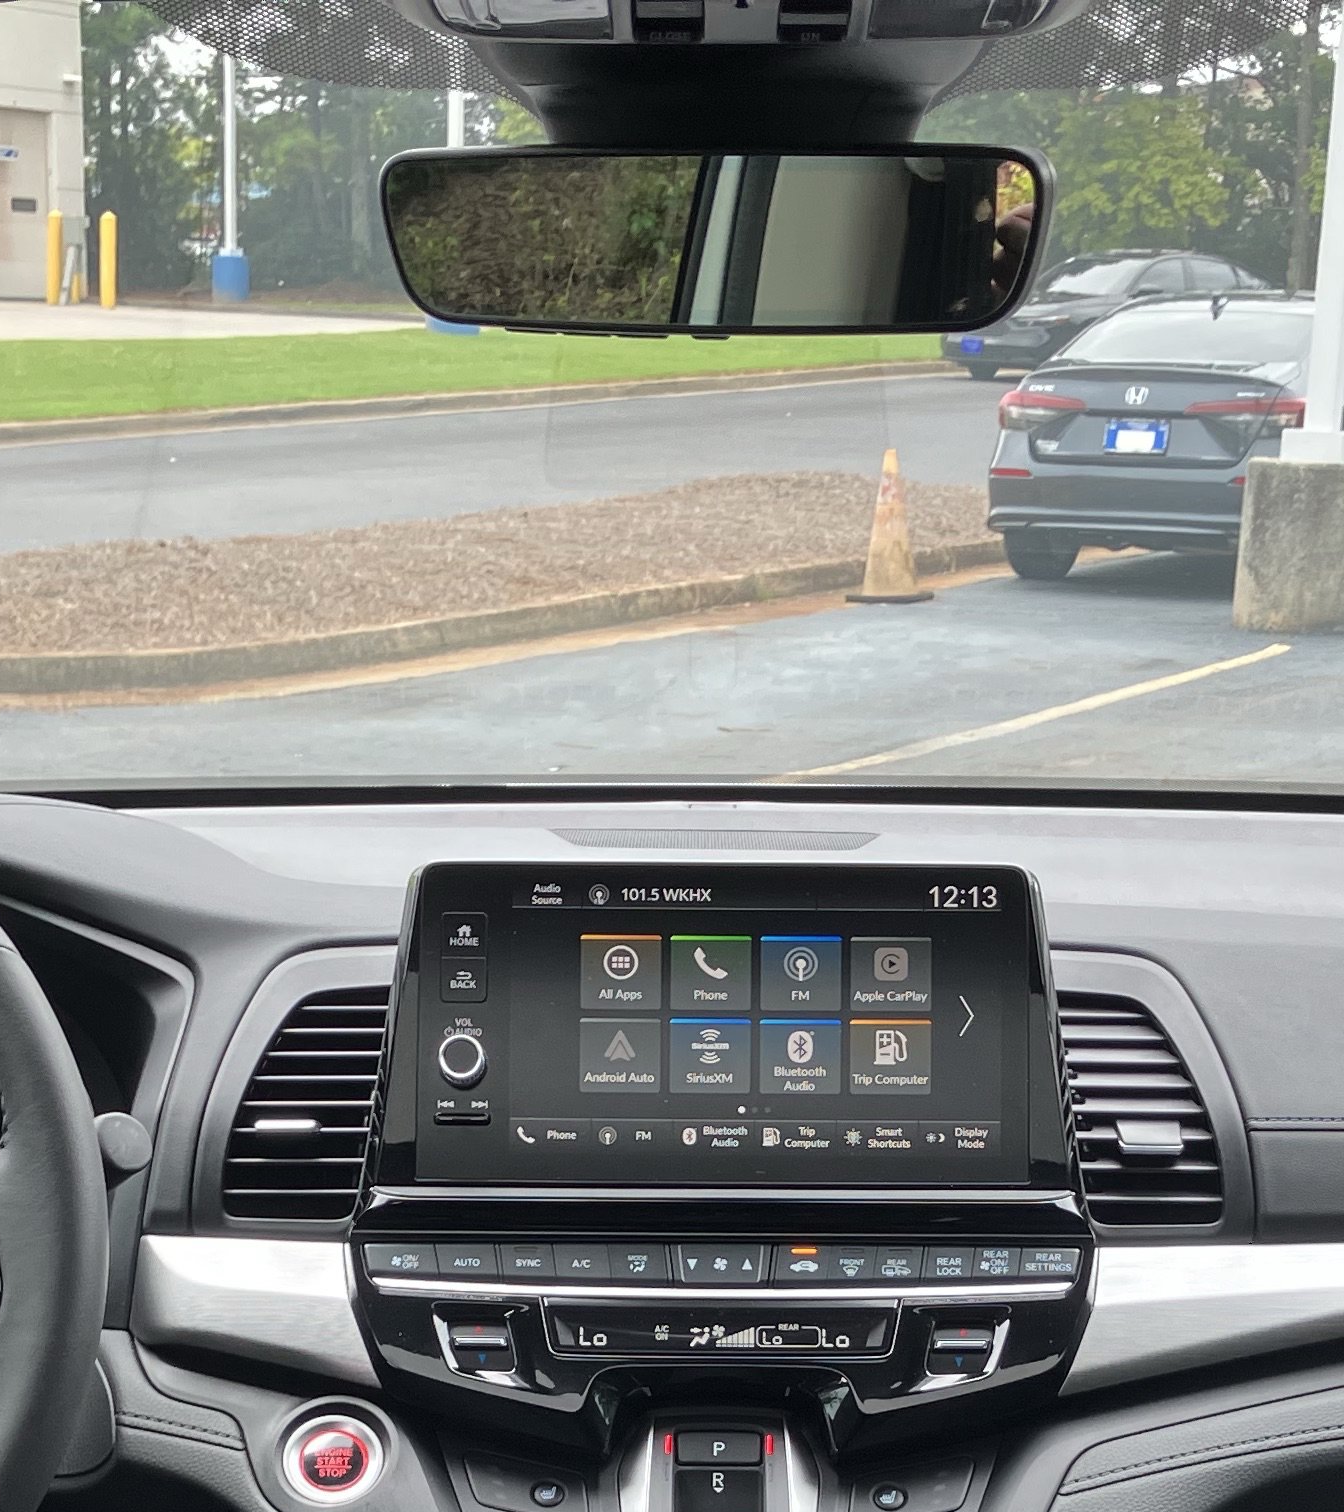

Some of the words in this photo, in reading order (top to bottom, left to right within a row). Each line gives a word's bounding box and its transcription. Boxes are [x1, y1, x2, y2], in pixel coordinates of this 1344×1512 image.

[533, 883, 562, 893] Audio
[531, 895, 563, 905] Source
[621, 888, 660, 902] 101.5
[662, 888, 712, 902] WKHX
[928, 886, 998, 908] 12:13
[449, 937, 479, 946] HOME
[450, 980, 476, 989] BACK
[598, 988, 613, 1000] All
[615, 989, 643, 1001] Apps
[693, 989, 728, 1000] Phone
[791, 990, 810, 1001] FM
[853, 991, 884, 1003] Apple
[886, 991, 928, 1003] CarPlay
[455, 1017, 473, 1026] VOL
[454, 1027, 482, 1036] AUDIO
[773, 1066, 826, 1077] Bluetooth
[583, 1072, 626, 1083] Android
[628, 1072, 655, 1083] Auto
[686, 1073, 733, 1084] SiriusXM
[852, 1074, 873, 1086] Trip
[874, 1074, 929, 1086] Computer
[783, 1081, 815, 1092] Audio
[546, 1130, 577, 1140] Phone
[635, 1130, 652, 1140] FM
[703, 1126, 748, 1136] Bluetooth
[798, 1126, 816, 1138] Trip
[875, 1127, 903, 1137] Smart
[954, 1127, 989, 1139] Display
[711, 1137, 739, 1147] Audio
[784, 1138, 830, 1149] Computer
[867, 1138, 911, 1149] Shortcuts
[957, 1139, 985, 1149] Mode
[983, 1250, 1009, 1259] REAR
[1035, 1253, 1061, 1262] REAR
[402, 1262, 419, 1270] OFF
[453, 1258, 481, 1267] AUTO
[515, 1258, 541, 1268] SYNC
[572, 1259, 591, 1268] A/C
[839, 1258, 864, 1266] FRONT
[936, 1257, 962, 1266] REAR
[936, 1267, 962, 1276] LOCK
[989, 1266, 1009, 1275] OFF
[1024, 1263, 1072, 1272] SETTINGS
[654, 1325, 670, 1333] A/C
[778, 1323, 799, 1331] REAR
[655, 1333, 669, 1341] ON
[712, 1441, 726, 1457] P
[316, 1457, 351, 1466] START
[318, 1468, 347, 1478] STOP
[712, 1472, 725, 1488] R
